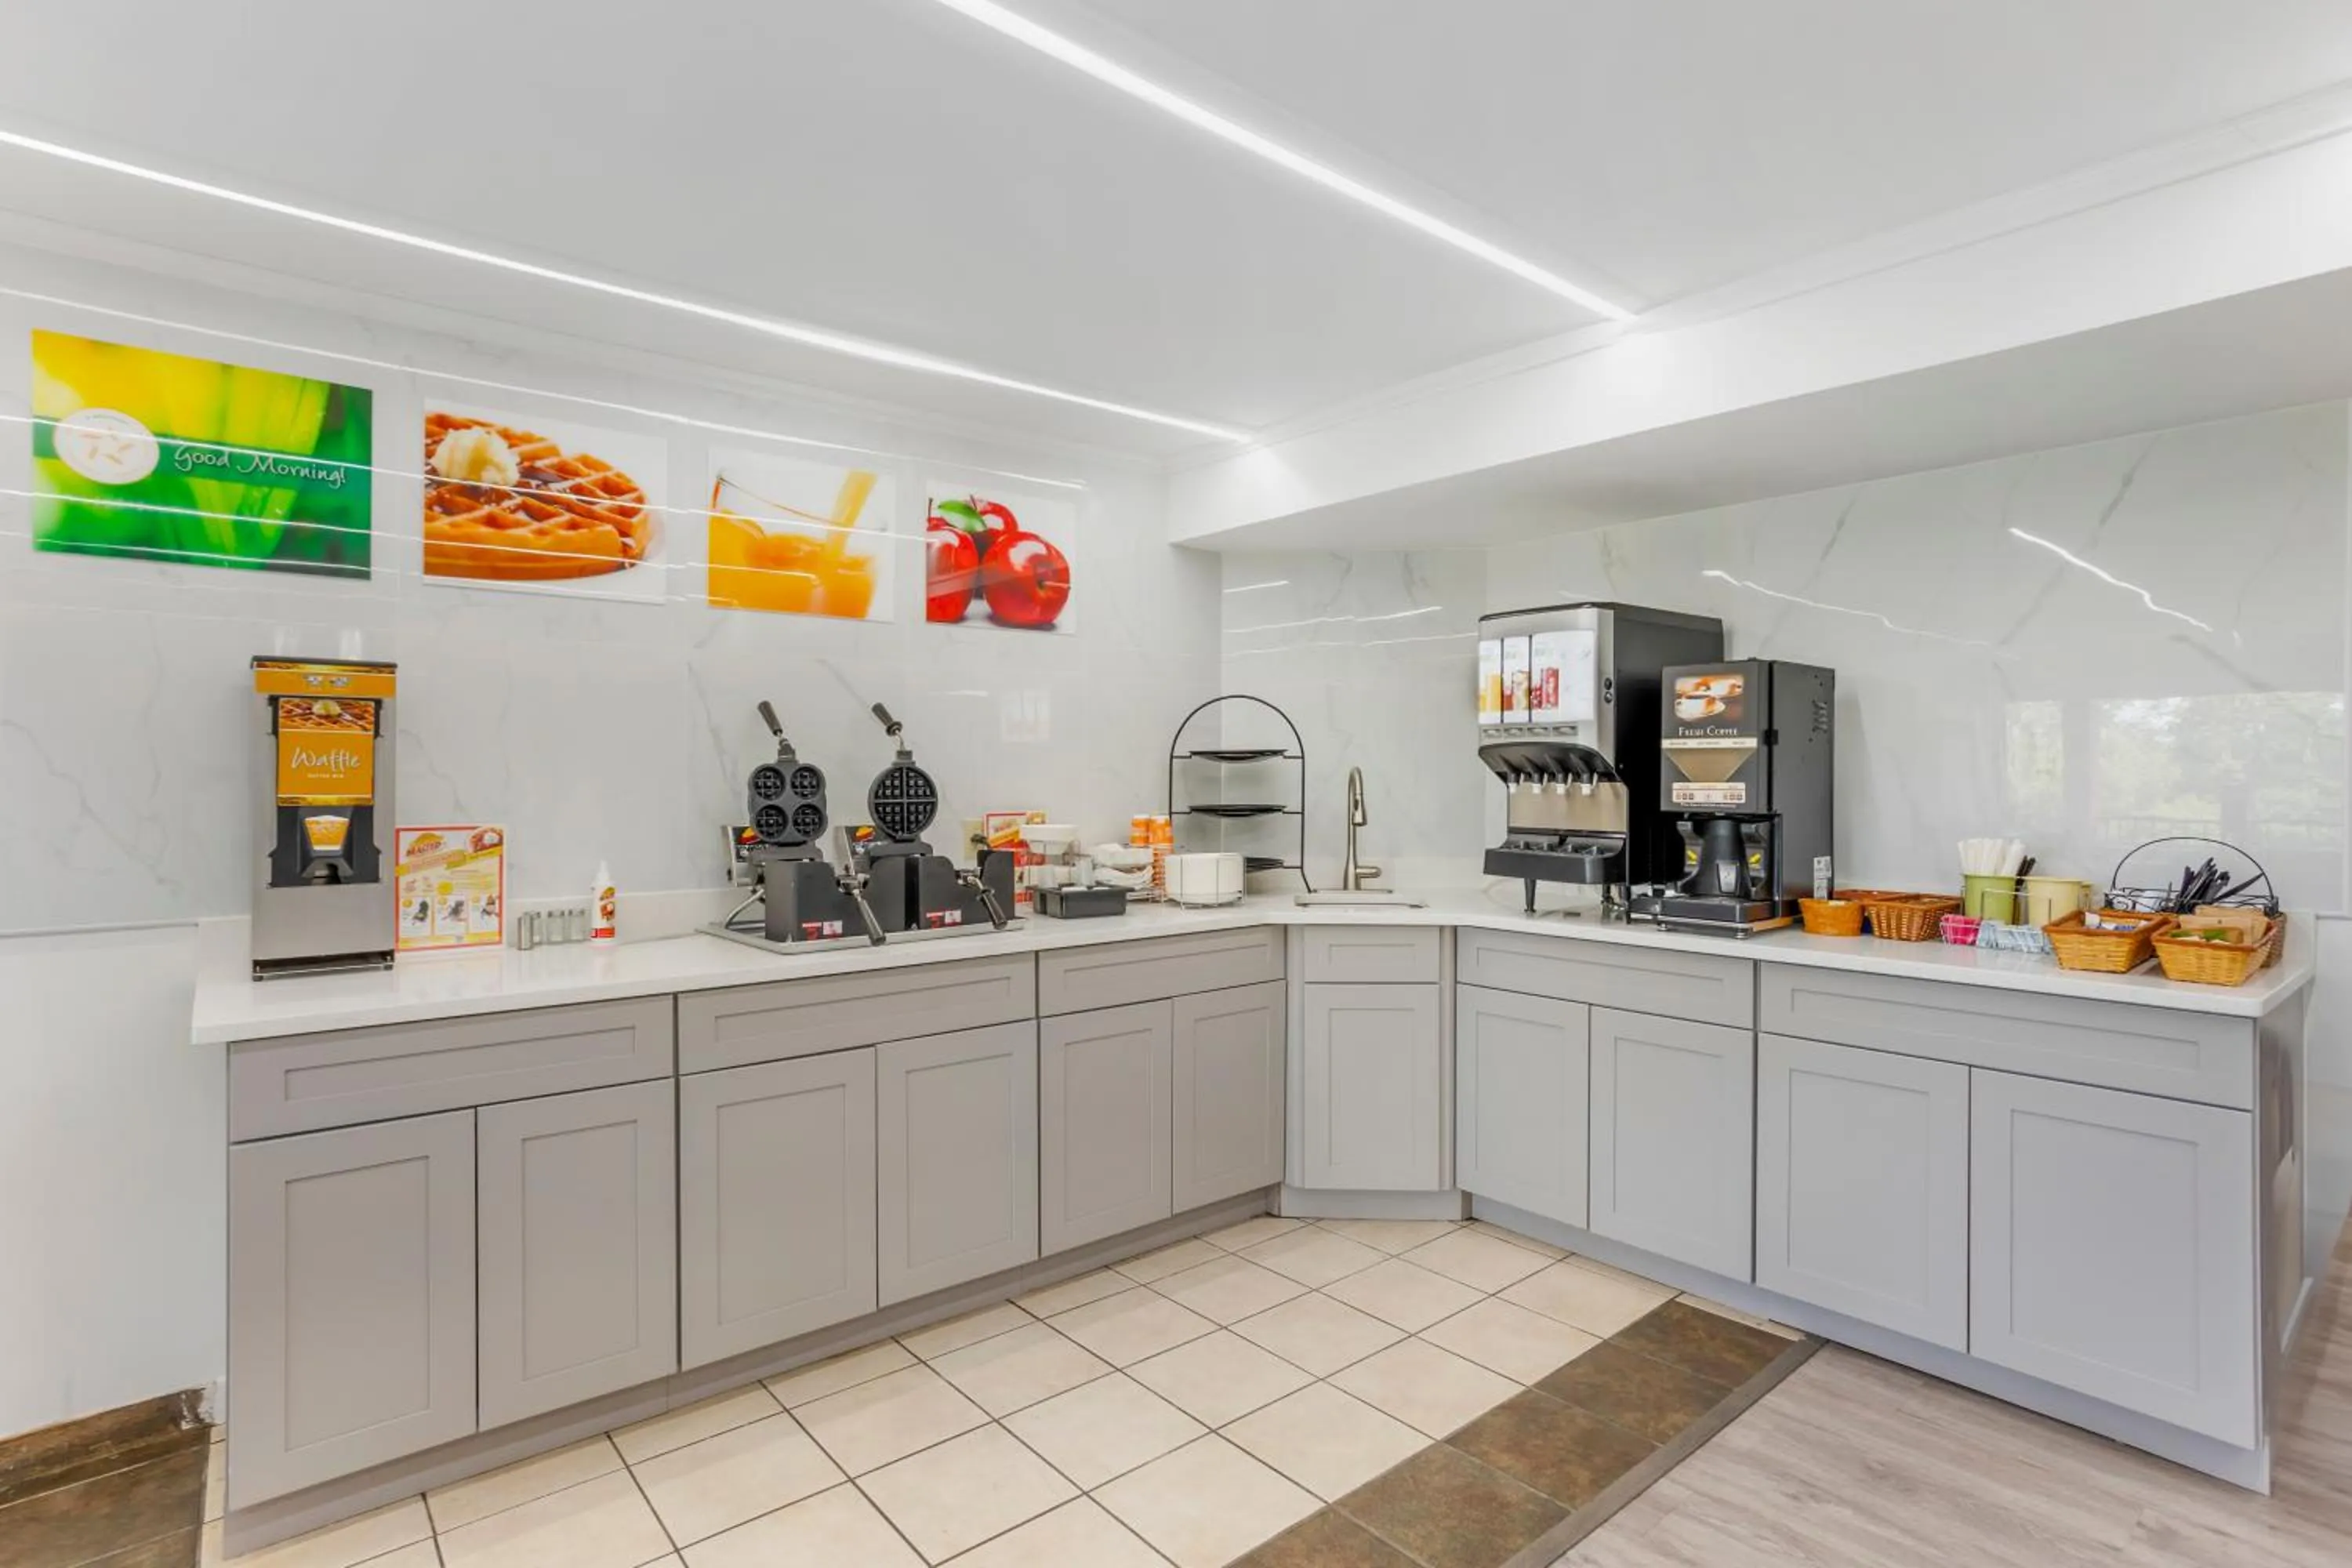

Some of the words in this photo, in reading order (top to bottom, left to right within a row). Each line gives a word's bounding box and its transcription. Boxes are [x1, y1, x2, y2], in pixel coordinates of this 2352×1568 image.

[174, 445, 230, 472] Good
[237, 455, 346, 489] Morning!
[291, 747, 361, 772] Waffle
